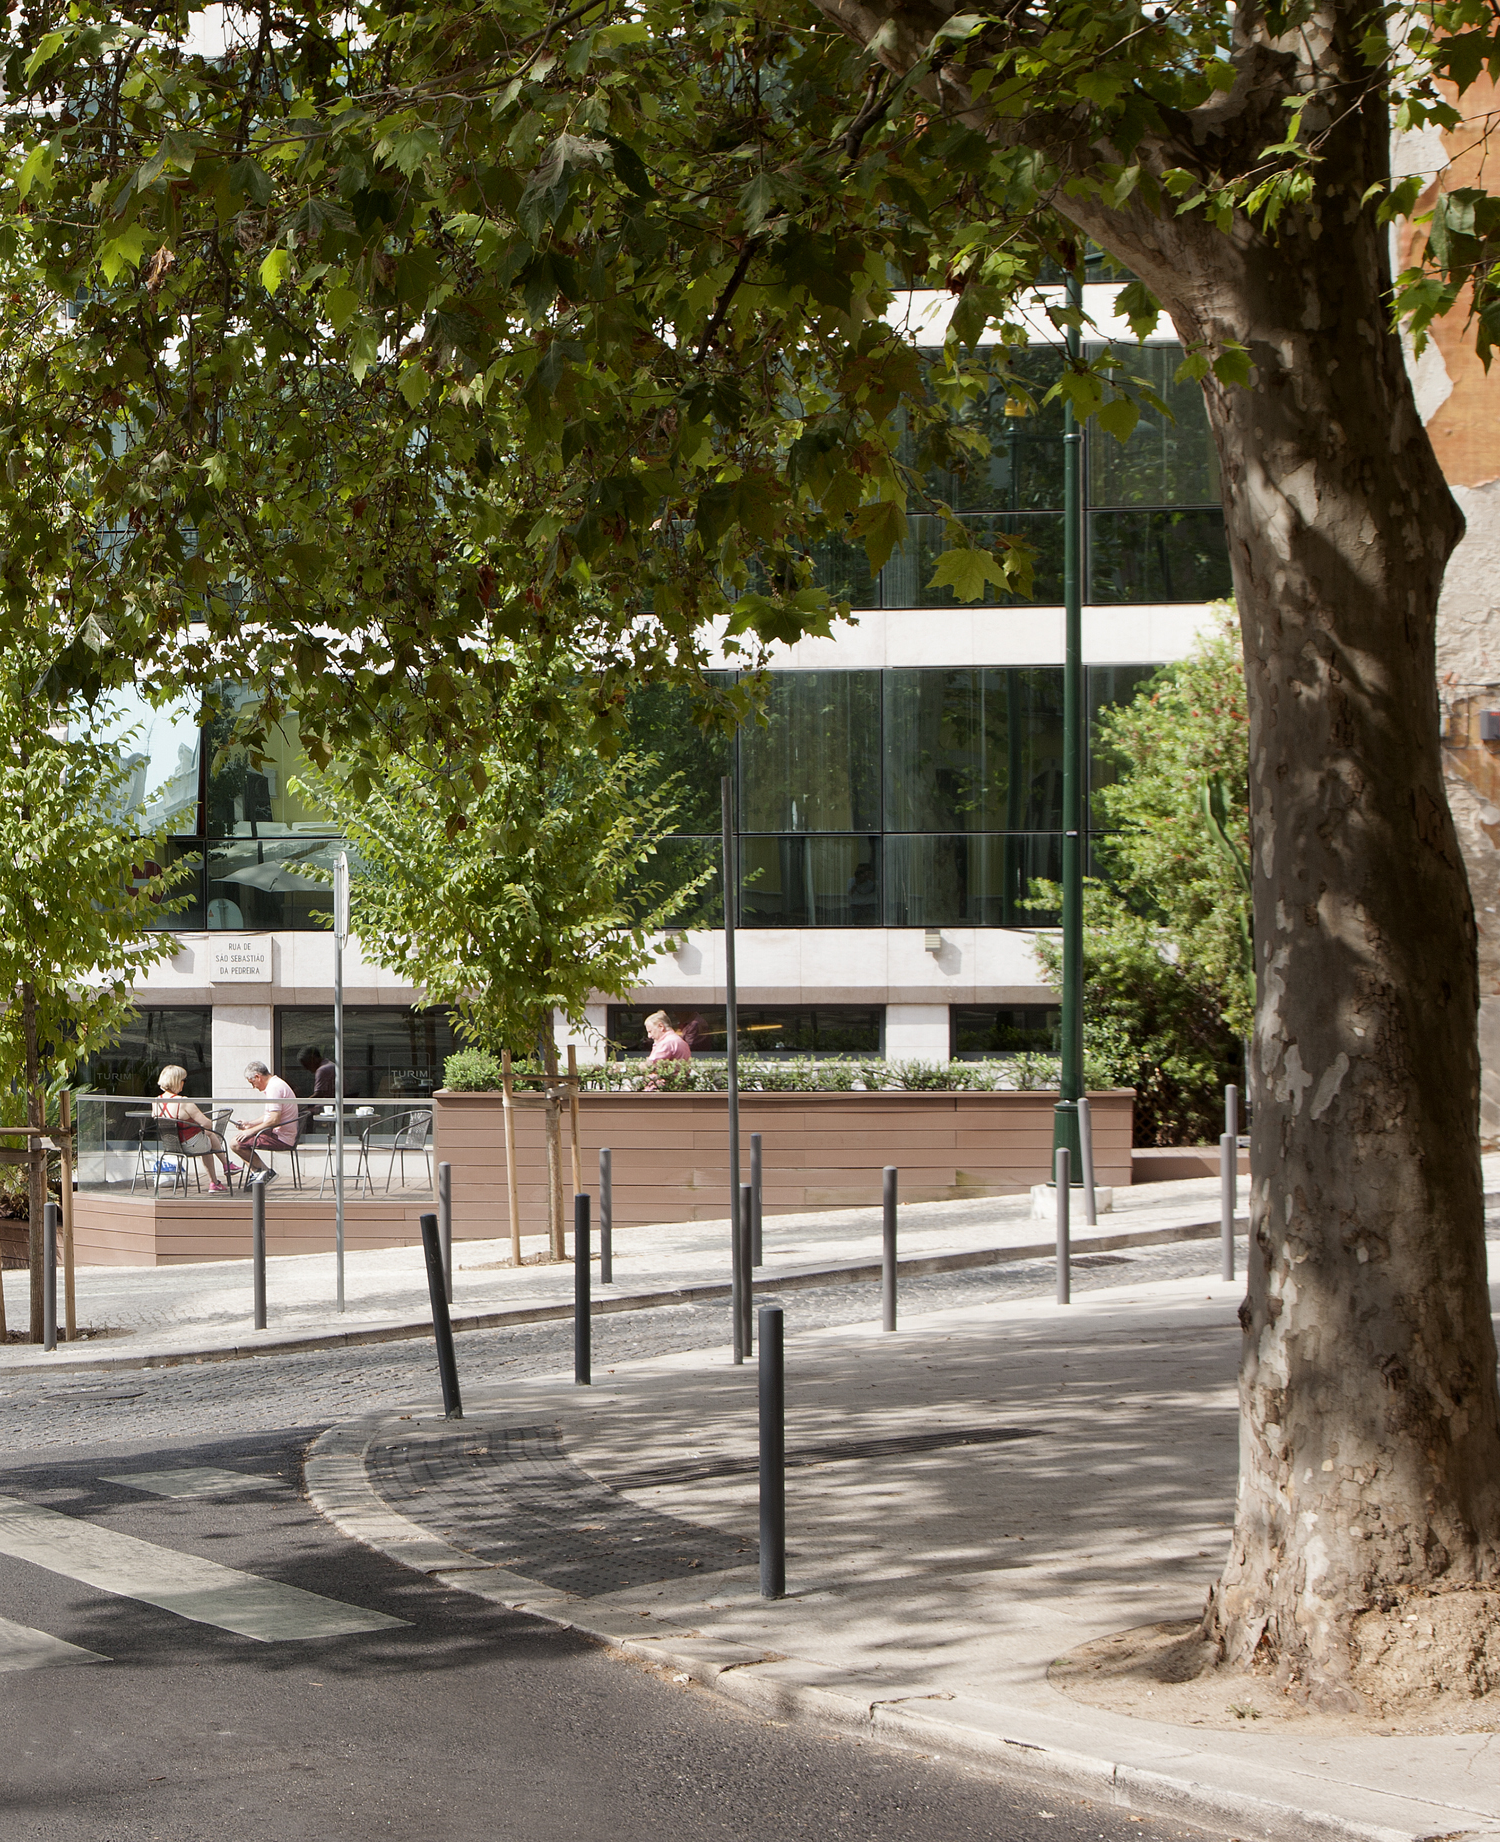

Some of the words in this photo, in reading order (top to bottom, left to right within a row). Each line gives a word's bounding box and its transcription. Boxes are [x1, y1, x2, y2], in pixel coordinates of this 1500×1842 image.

[228, 942, 241, 951] RUA
[243, 942, 252, 951] DE
[215, 953, 229, 963] SÃO
[230, 953, 265, 963] SEBASTIÃO
[219, 966, 229, 975] DA
[231, 966, 260, 975] PEDREIRA
[96, 1072, 132, 1083] TURIM
[391, 1069, 428, 1081] TURIM
